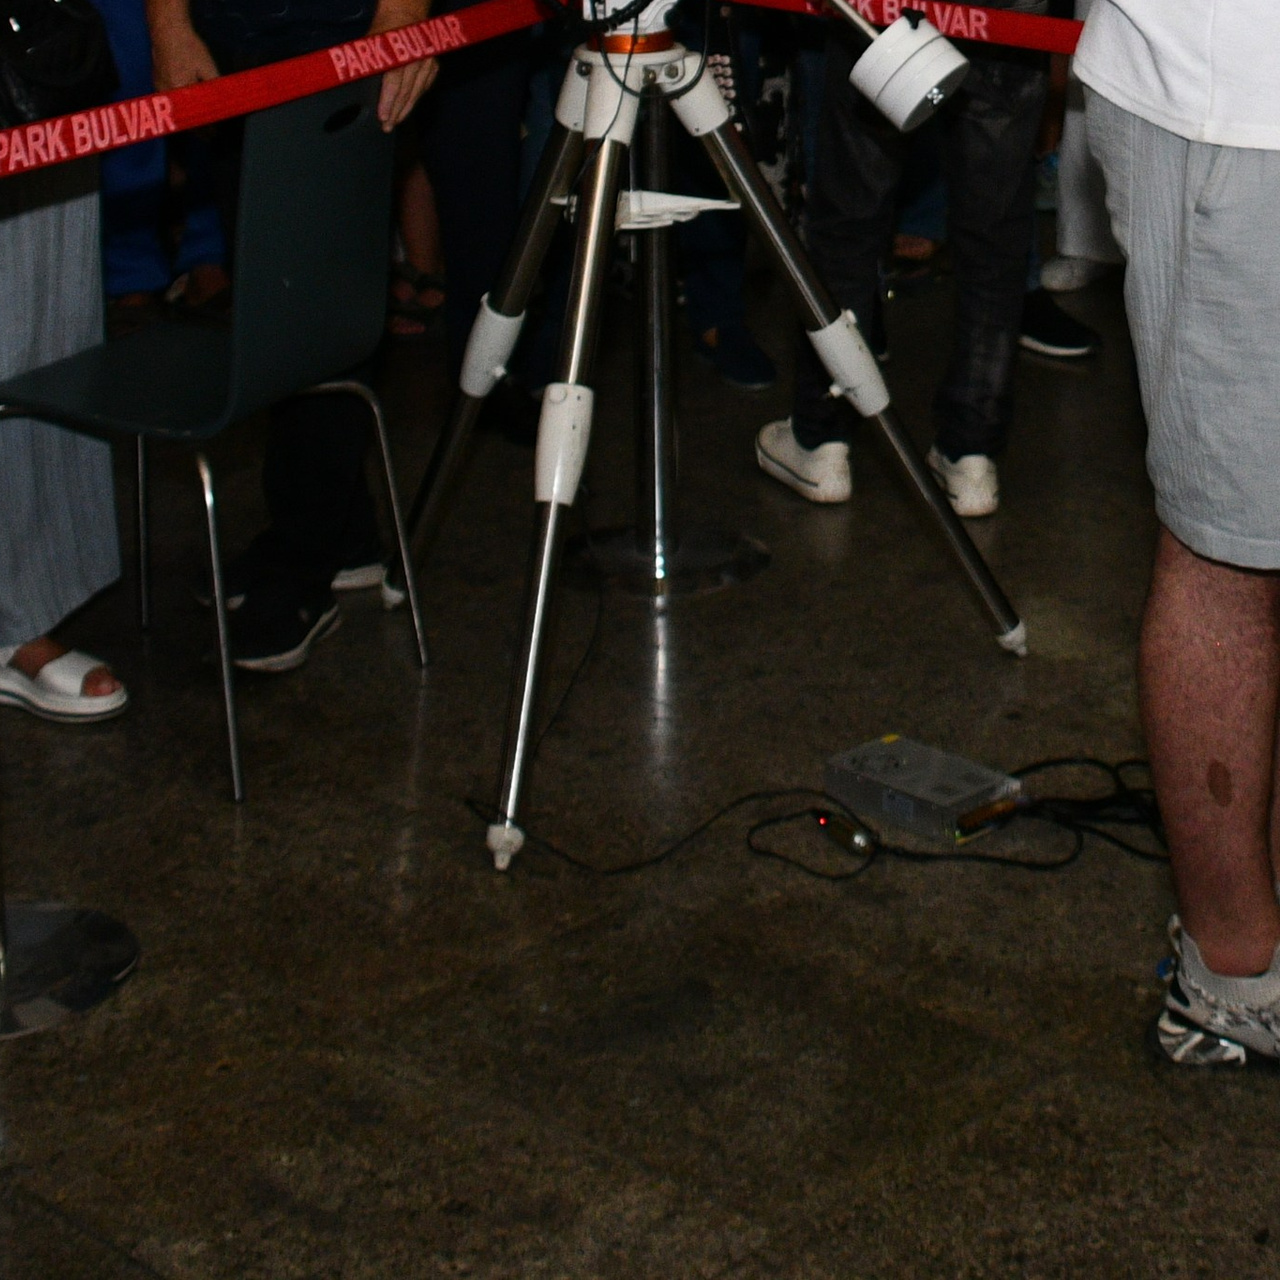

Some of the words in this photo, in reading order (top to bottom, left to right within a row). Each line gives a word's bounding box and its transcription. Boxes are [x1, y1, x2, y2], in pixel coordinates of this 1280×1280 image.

[328, 34, 393, 81] PARK
[385, 14, 468, 61] BULVAR
[0, 119, 69, 172] PARK
[71, 95, 177, 155] BULVAR
